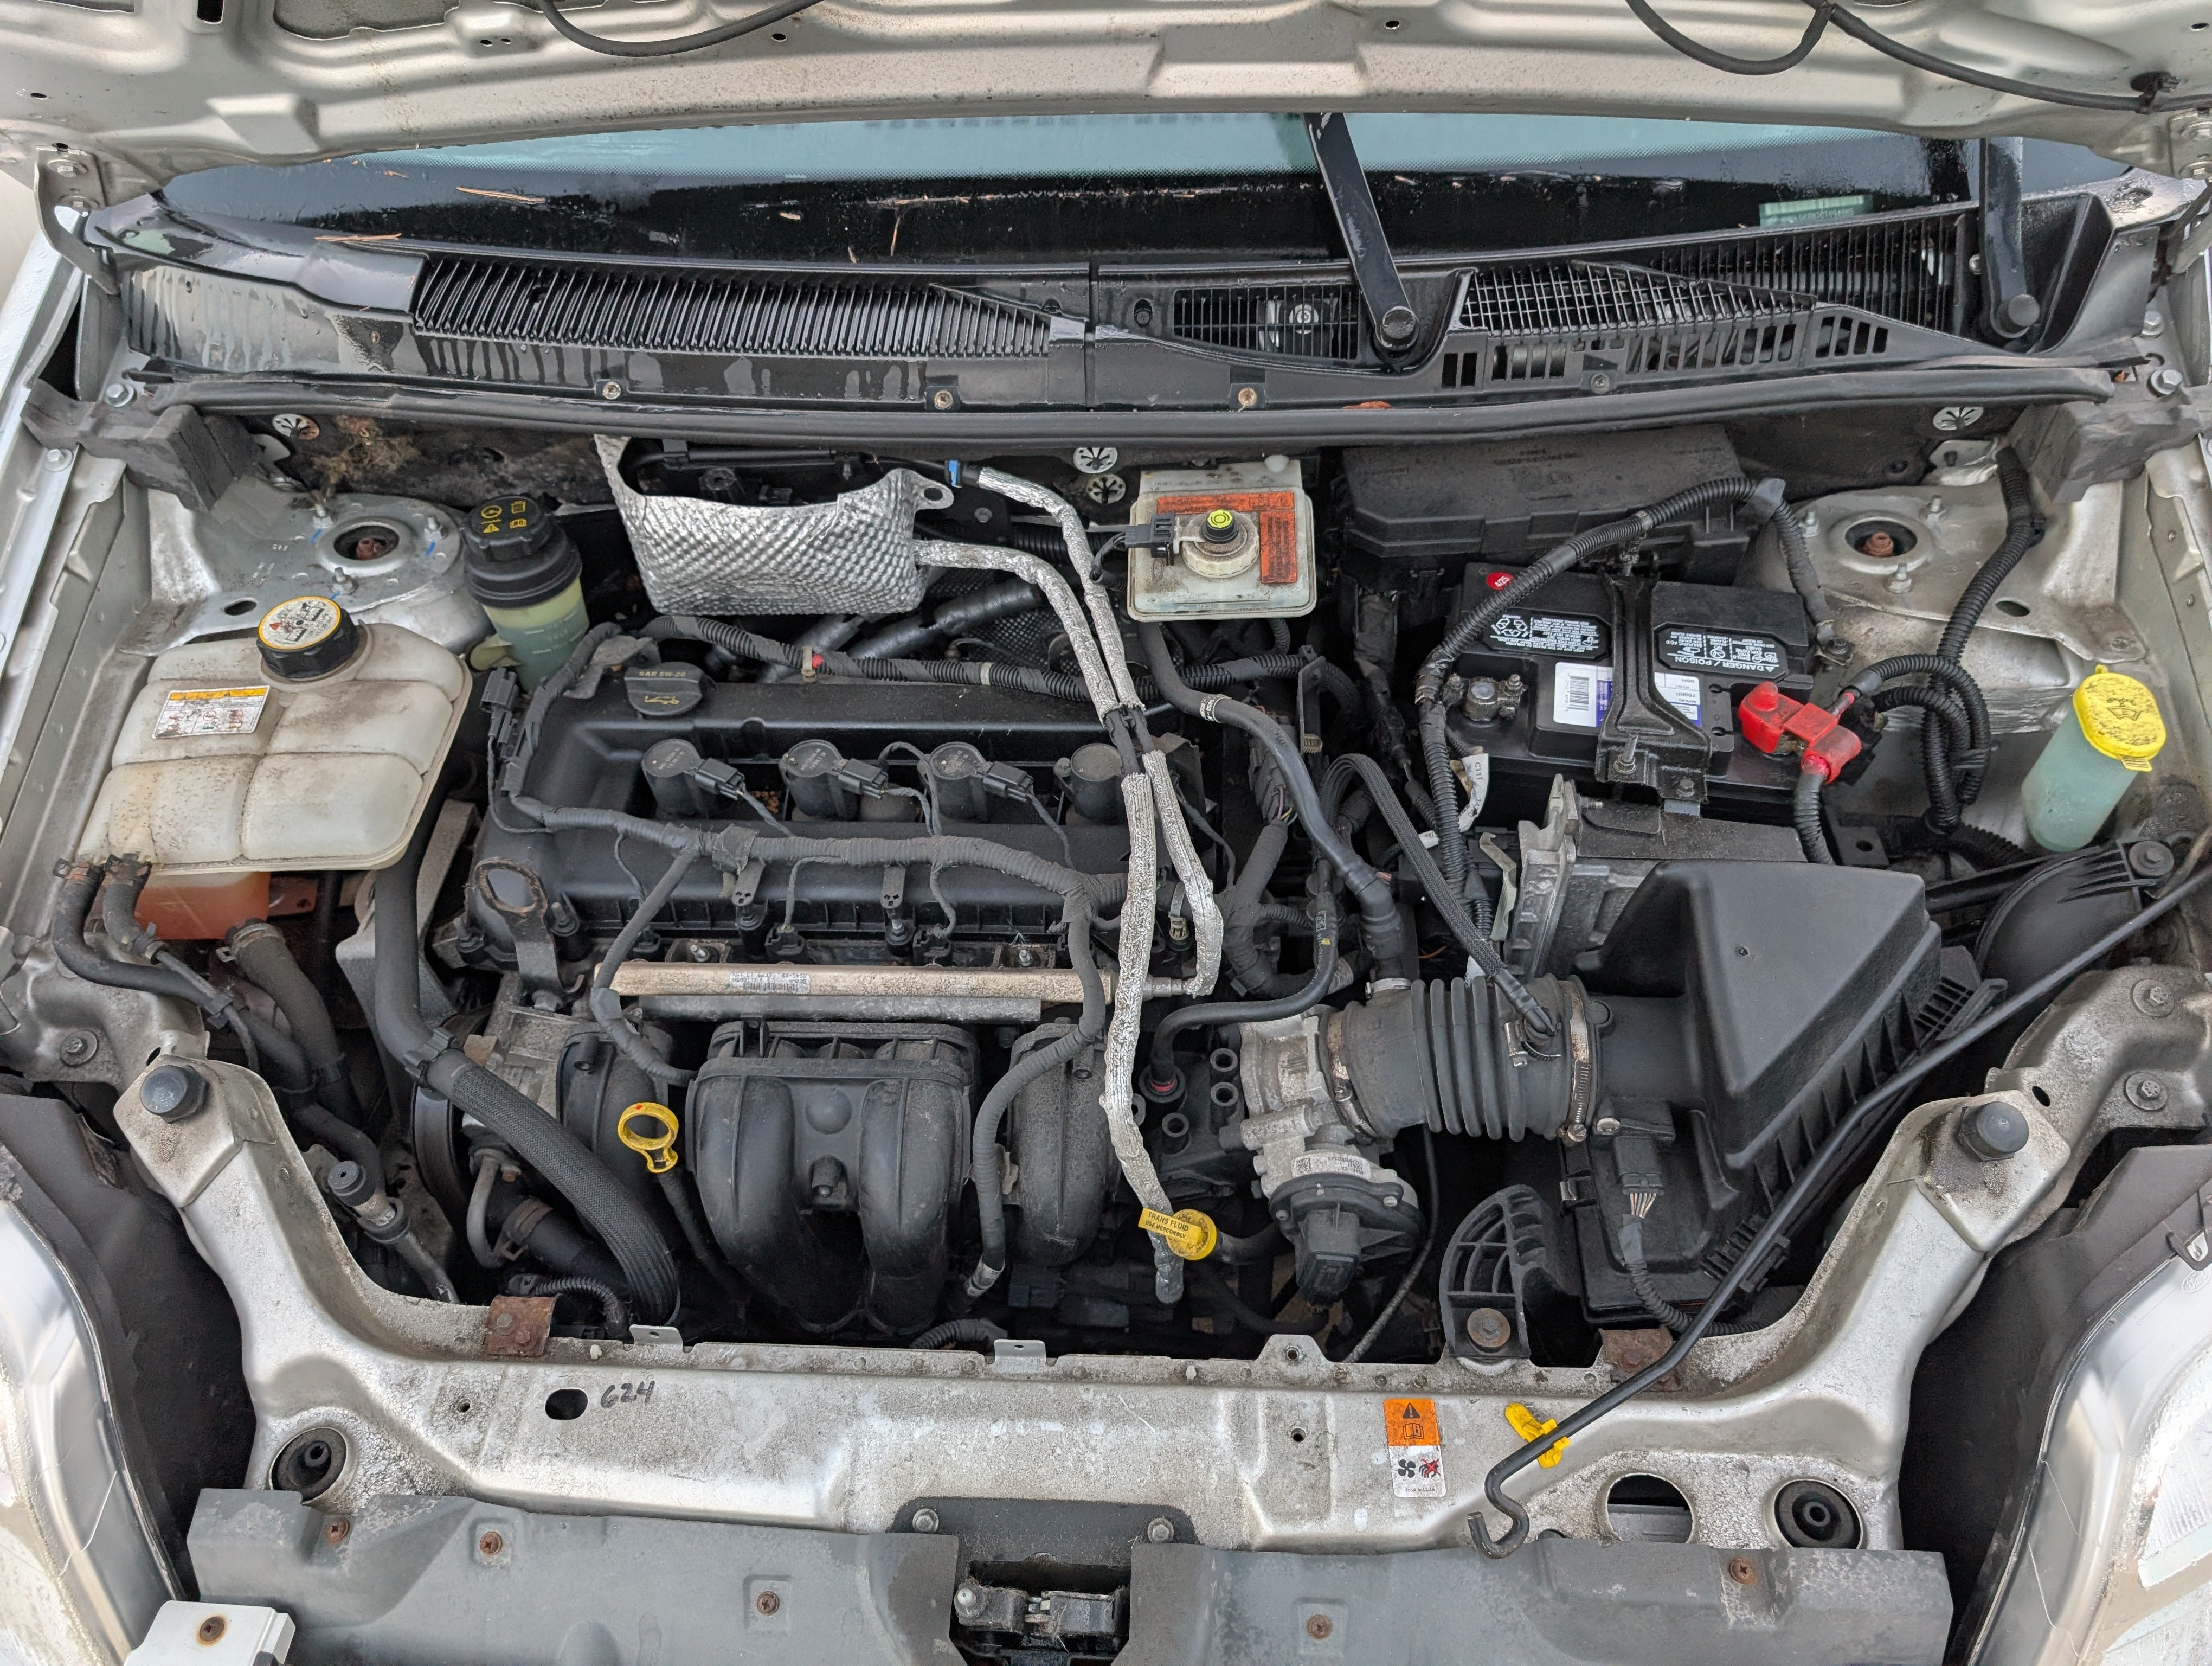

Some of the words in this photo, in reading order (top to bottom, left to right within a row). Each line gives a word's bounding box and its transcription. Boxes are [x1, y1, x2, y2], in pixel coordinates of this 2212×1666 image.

[1494, 576, 1509, 587] 4/25
[1675, 656, 1712, 665] POISON
[1722, 662, 1764, 671] DANGER
[1148, 1211, 1169, 1224] TRANS
[1169, 1220, 1189, 1231] FLUID
